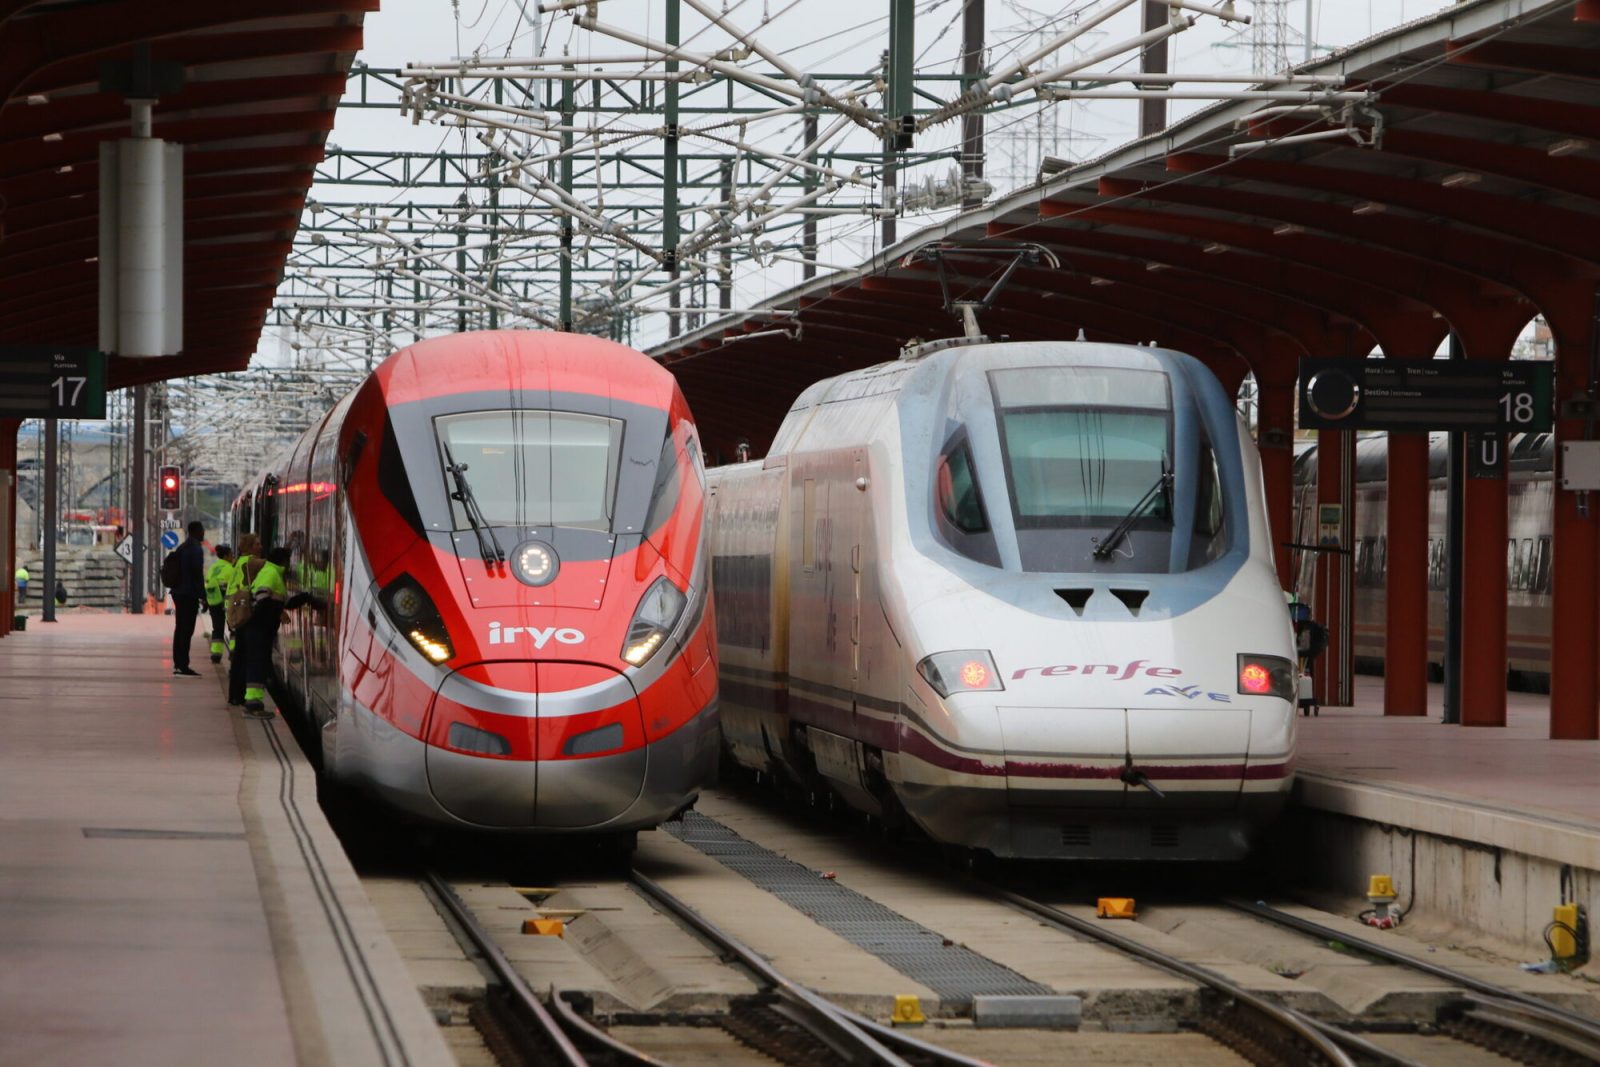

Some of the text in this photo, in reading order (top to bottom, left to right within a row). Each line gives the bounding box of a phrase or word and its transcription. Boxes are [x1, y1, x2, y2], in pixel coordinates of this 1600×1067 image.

[51, 376, 87, 407] 17
[1499, 392, 1534, 423] 18
[1482, 440, 1498, 466] U
[488, 621, 585, 649] iryo
[1011, 659, 1183, 681] renfe
[1144, 684, 1232, 703] AVE
